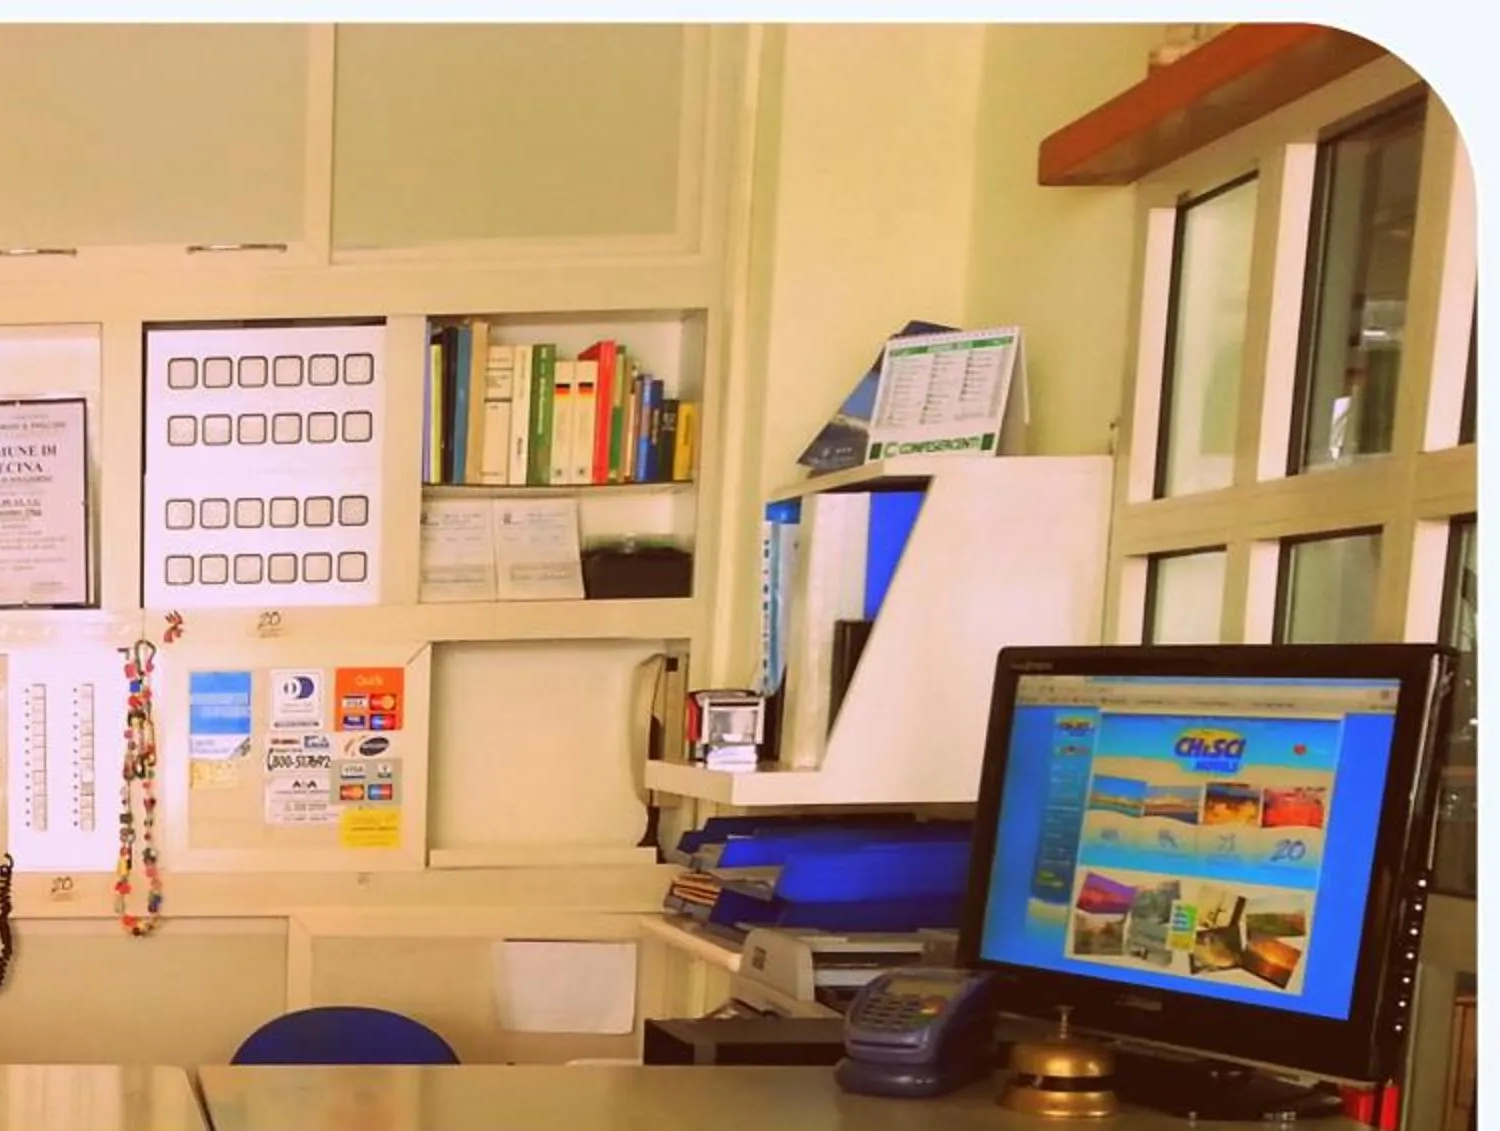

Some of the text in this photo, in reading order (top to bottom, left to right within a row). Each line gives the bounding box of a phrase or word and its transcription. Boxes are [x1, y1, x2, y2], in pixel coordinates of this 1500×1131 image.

[41, 444, 58, 457] DI
[257, 610, 282, 631] 20
[1269, 837, 1308, 862] 20
[49, 876, 74, 896] 20
